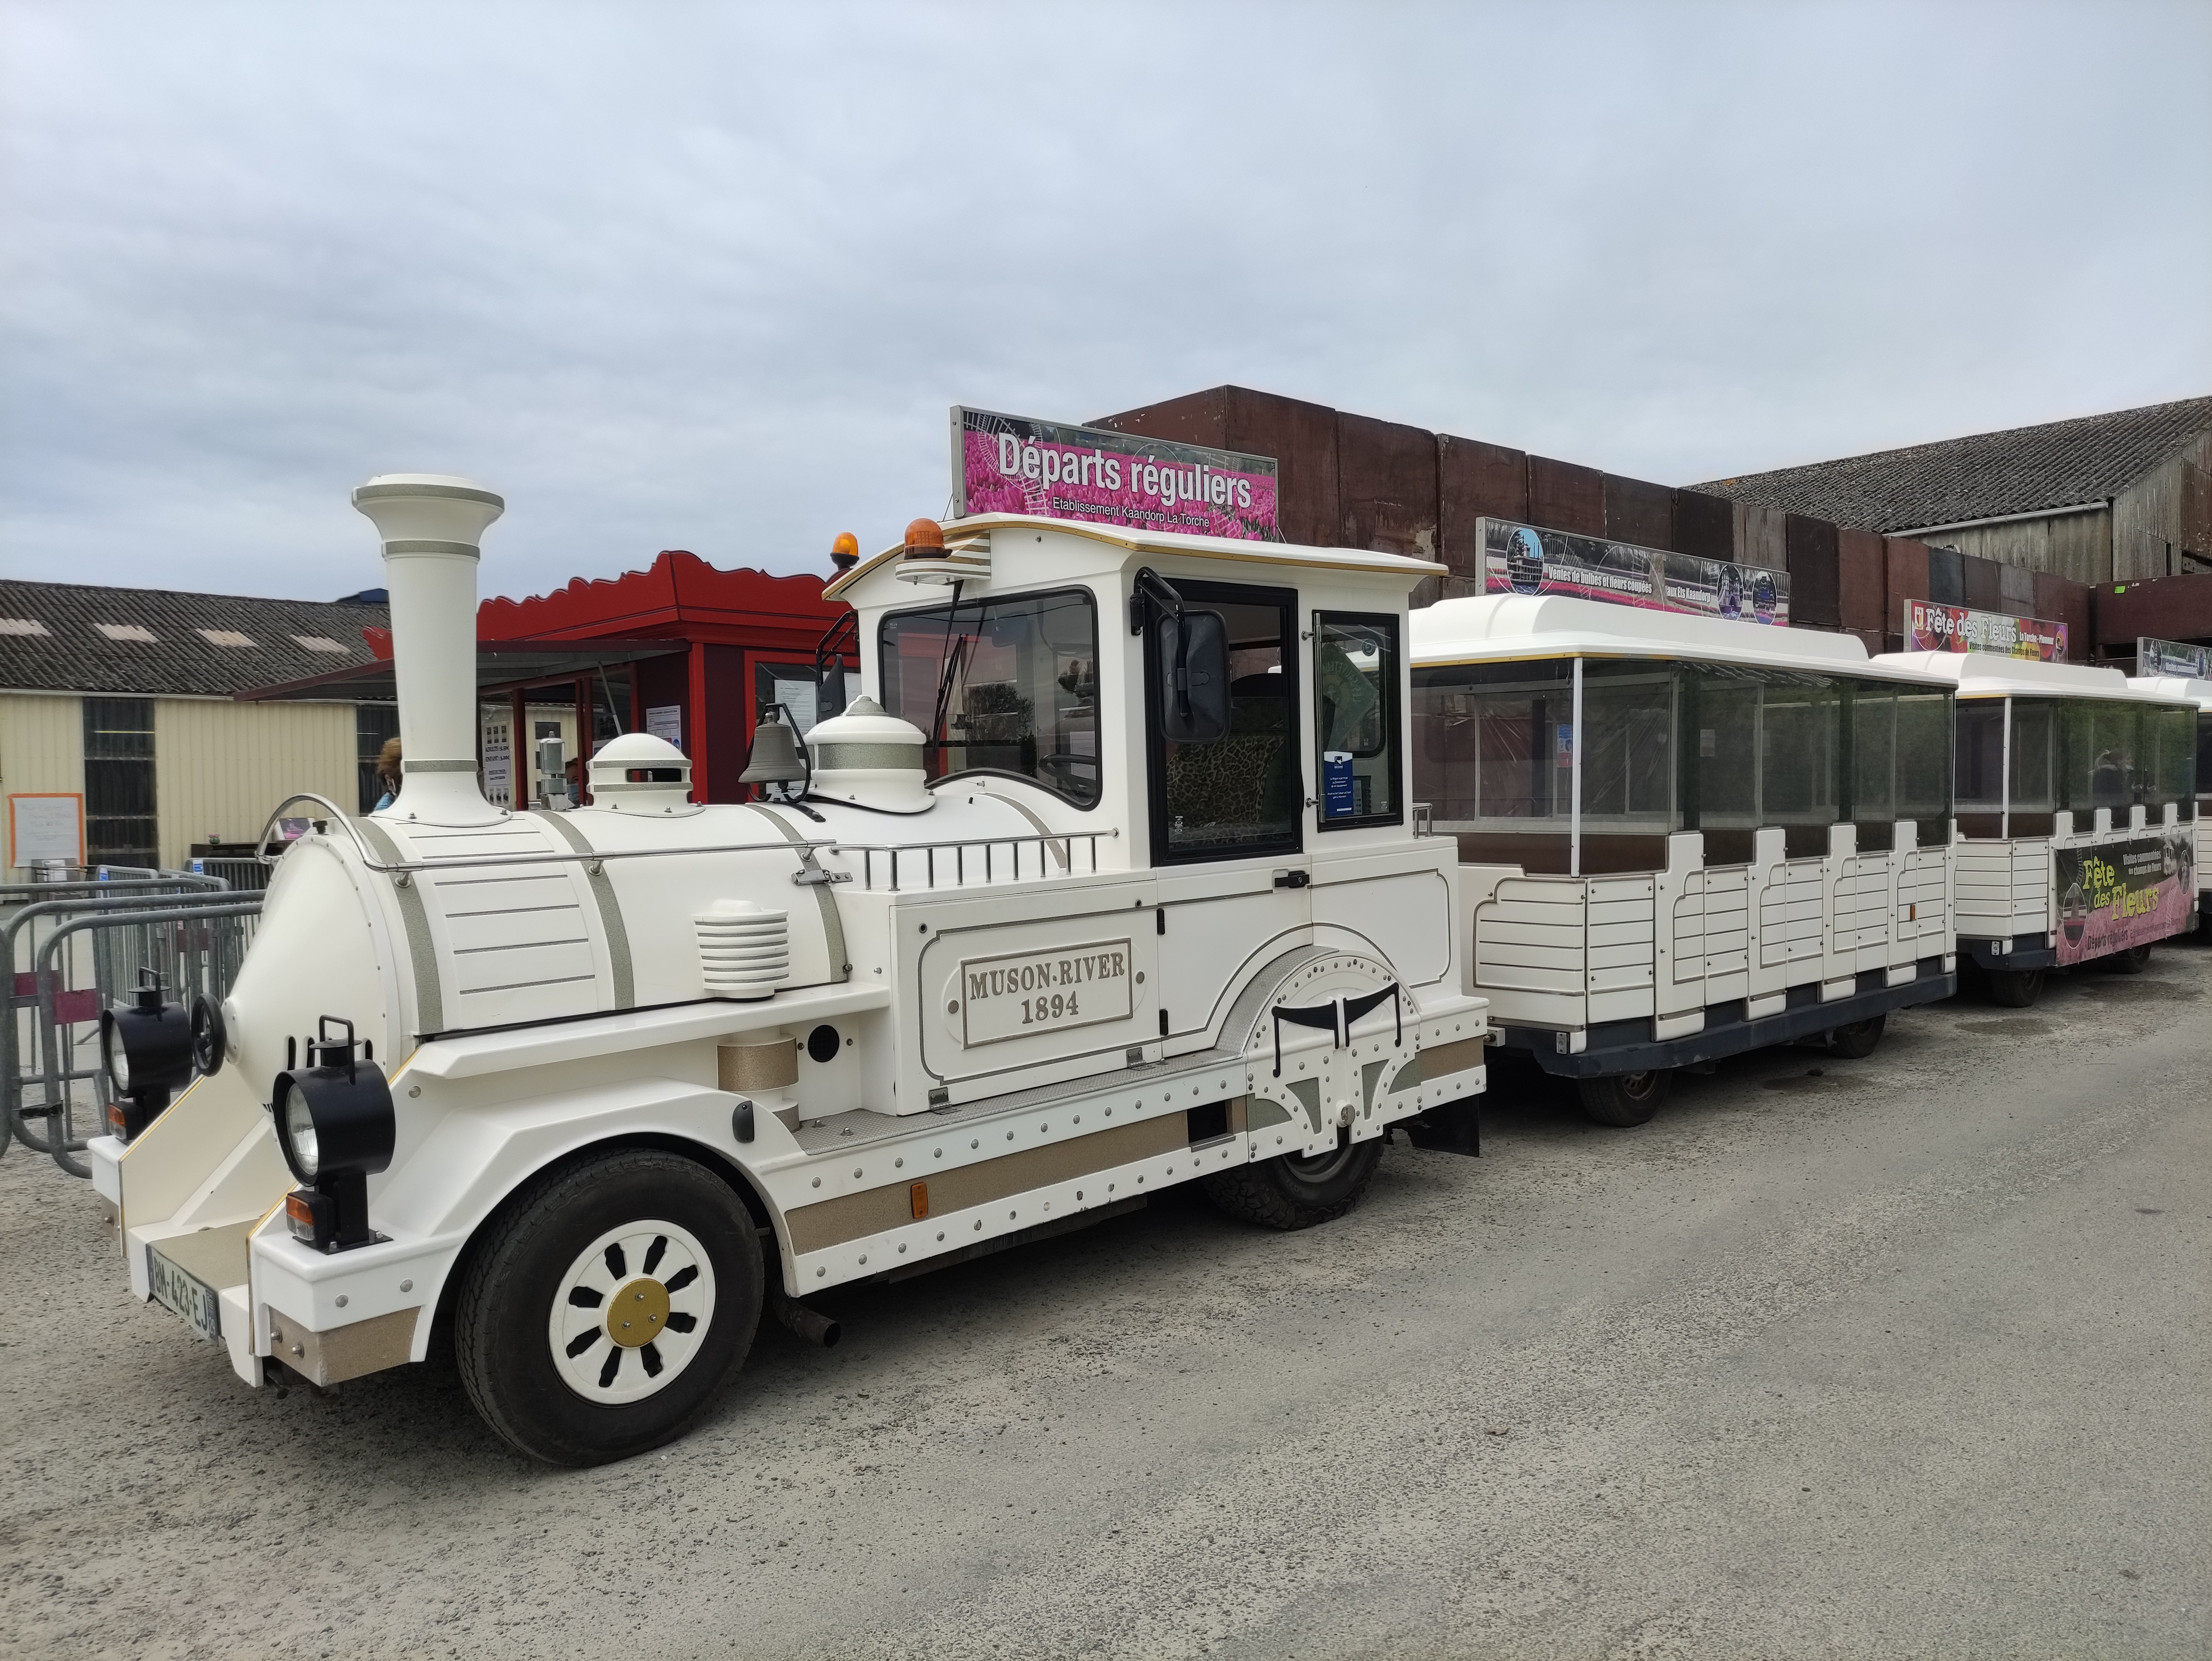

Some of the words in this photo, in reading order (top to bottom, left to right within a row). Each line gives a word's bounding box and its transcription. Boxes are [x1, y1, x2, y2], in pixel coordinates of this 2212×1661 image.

[998, 432, 1121, 490] Départs
[1131, 454, 1251, 508] réguliers
[1052, 497, 1119, 516] Etablissement
[1122, 506, 1164, 524] Kaandorp
[1167, 512, 1178, 523] La
[1180, 513, 1209, 527] Torche
[1548, 566, 1571, 581] Ventes
[1572, 570, 1580, 583] de
[1581, 572, 1602, 587] bulbes
[1603, 577, 1609, 587] et
[1609, 578, 1626, 590] fleurs
[1627, 580, 1652, 594] coupées
[1686, 587, 1710, 603] Kaandorp
[1926, 608, 1955, 635] Fête
[1957, 612, 1978, 638] des
[1980, 616, 2017, 642] Fleurs
[2019, 631, 2024, 641] La
[1969, 642, 1981, 651] Visites
[2082, 856, 2115, 889] Fête
[2123, 853, 2137, 865] Visites
[2094, 887, 2110, 908] des
[2112, 883, 2159, 920] Fleurs
[2088, 934, 2107, 951] Départs
[2107, 929, 2128, 947] réguliers
[1021, 990, 1078, 1024] 1894
